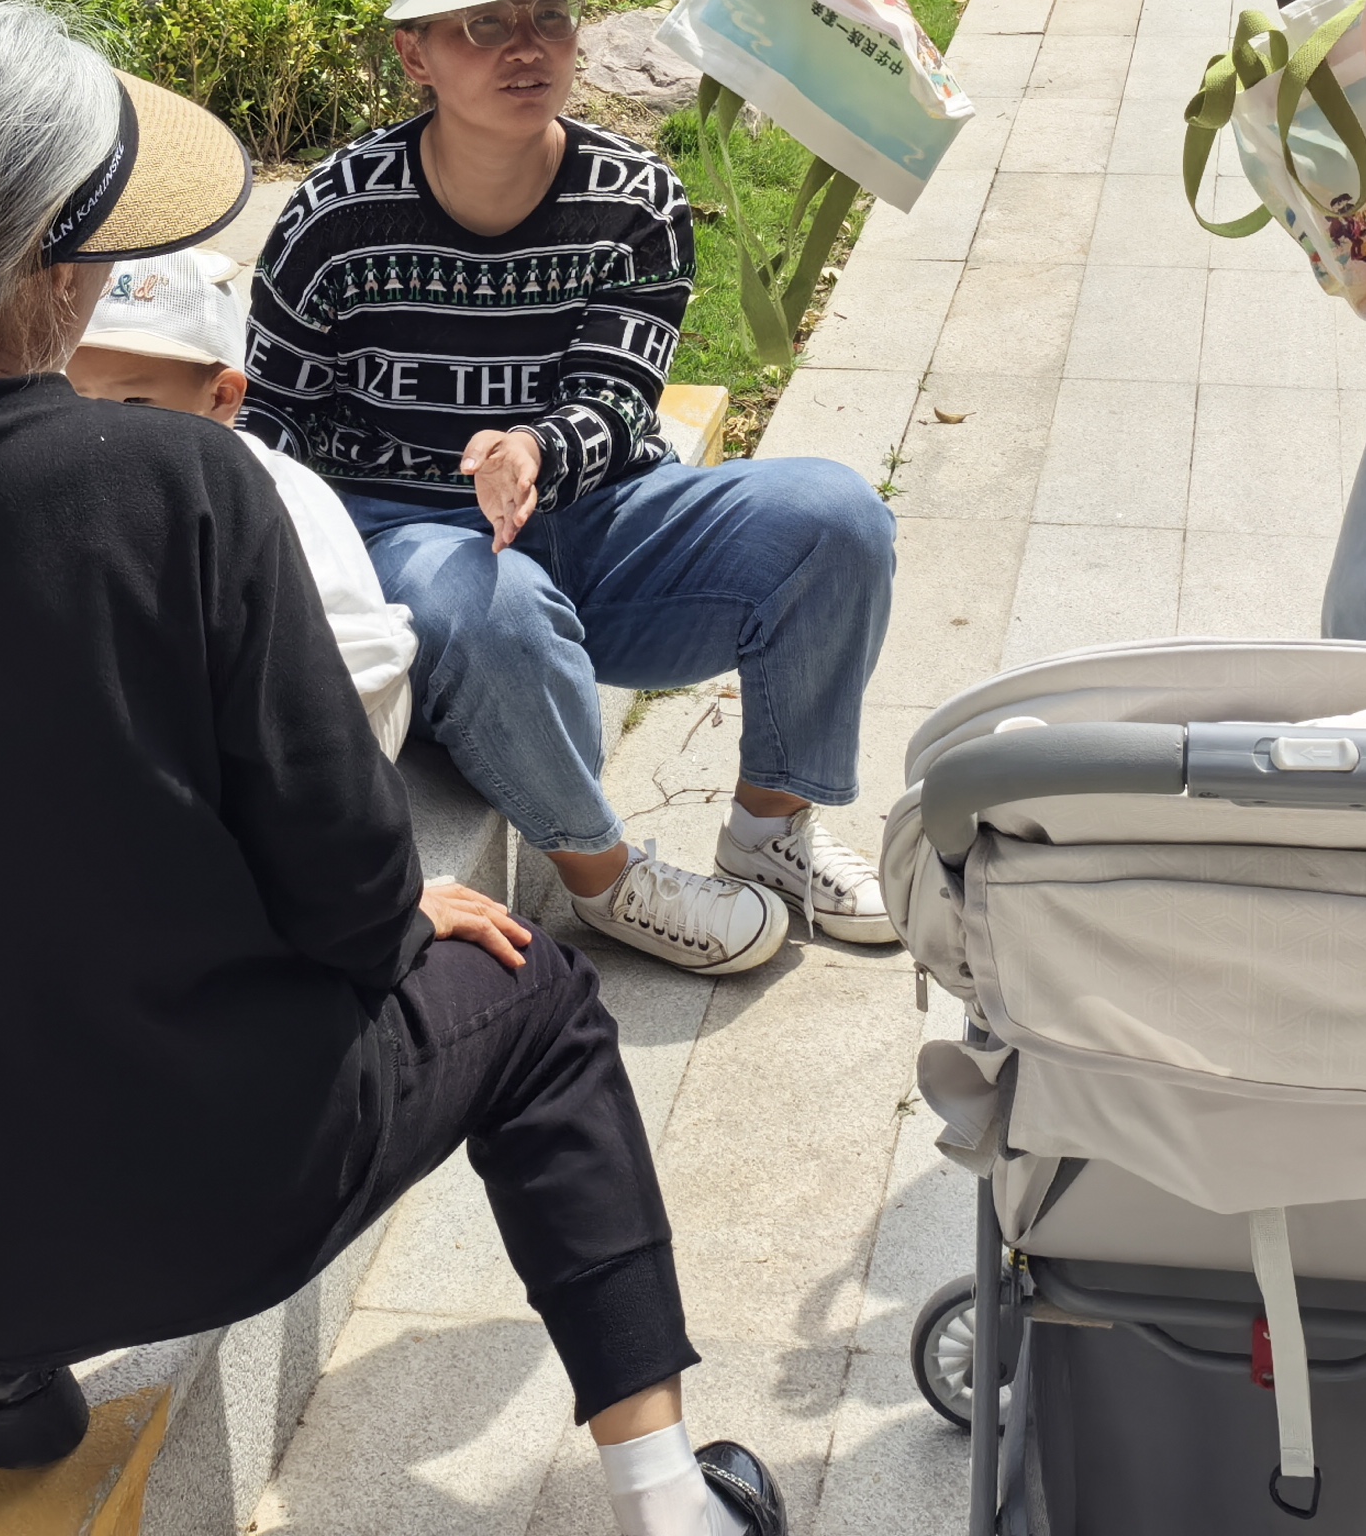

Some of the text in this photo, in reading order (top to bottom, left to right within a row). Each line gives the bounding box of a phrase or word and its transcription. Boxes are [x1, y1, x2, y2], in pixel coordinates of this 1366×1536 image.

[810, 0, 906, 77] 中华民族一家亲
[336, 357, 419, 401] IZE
[450, 365, 541, 405] THE
